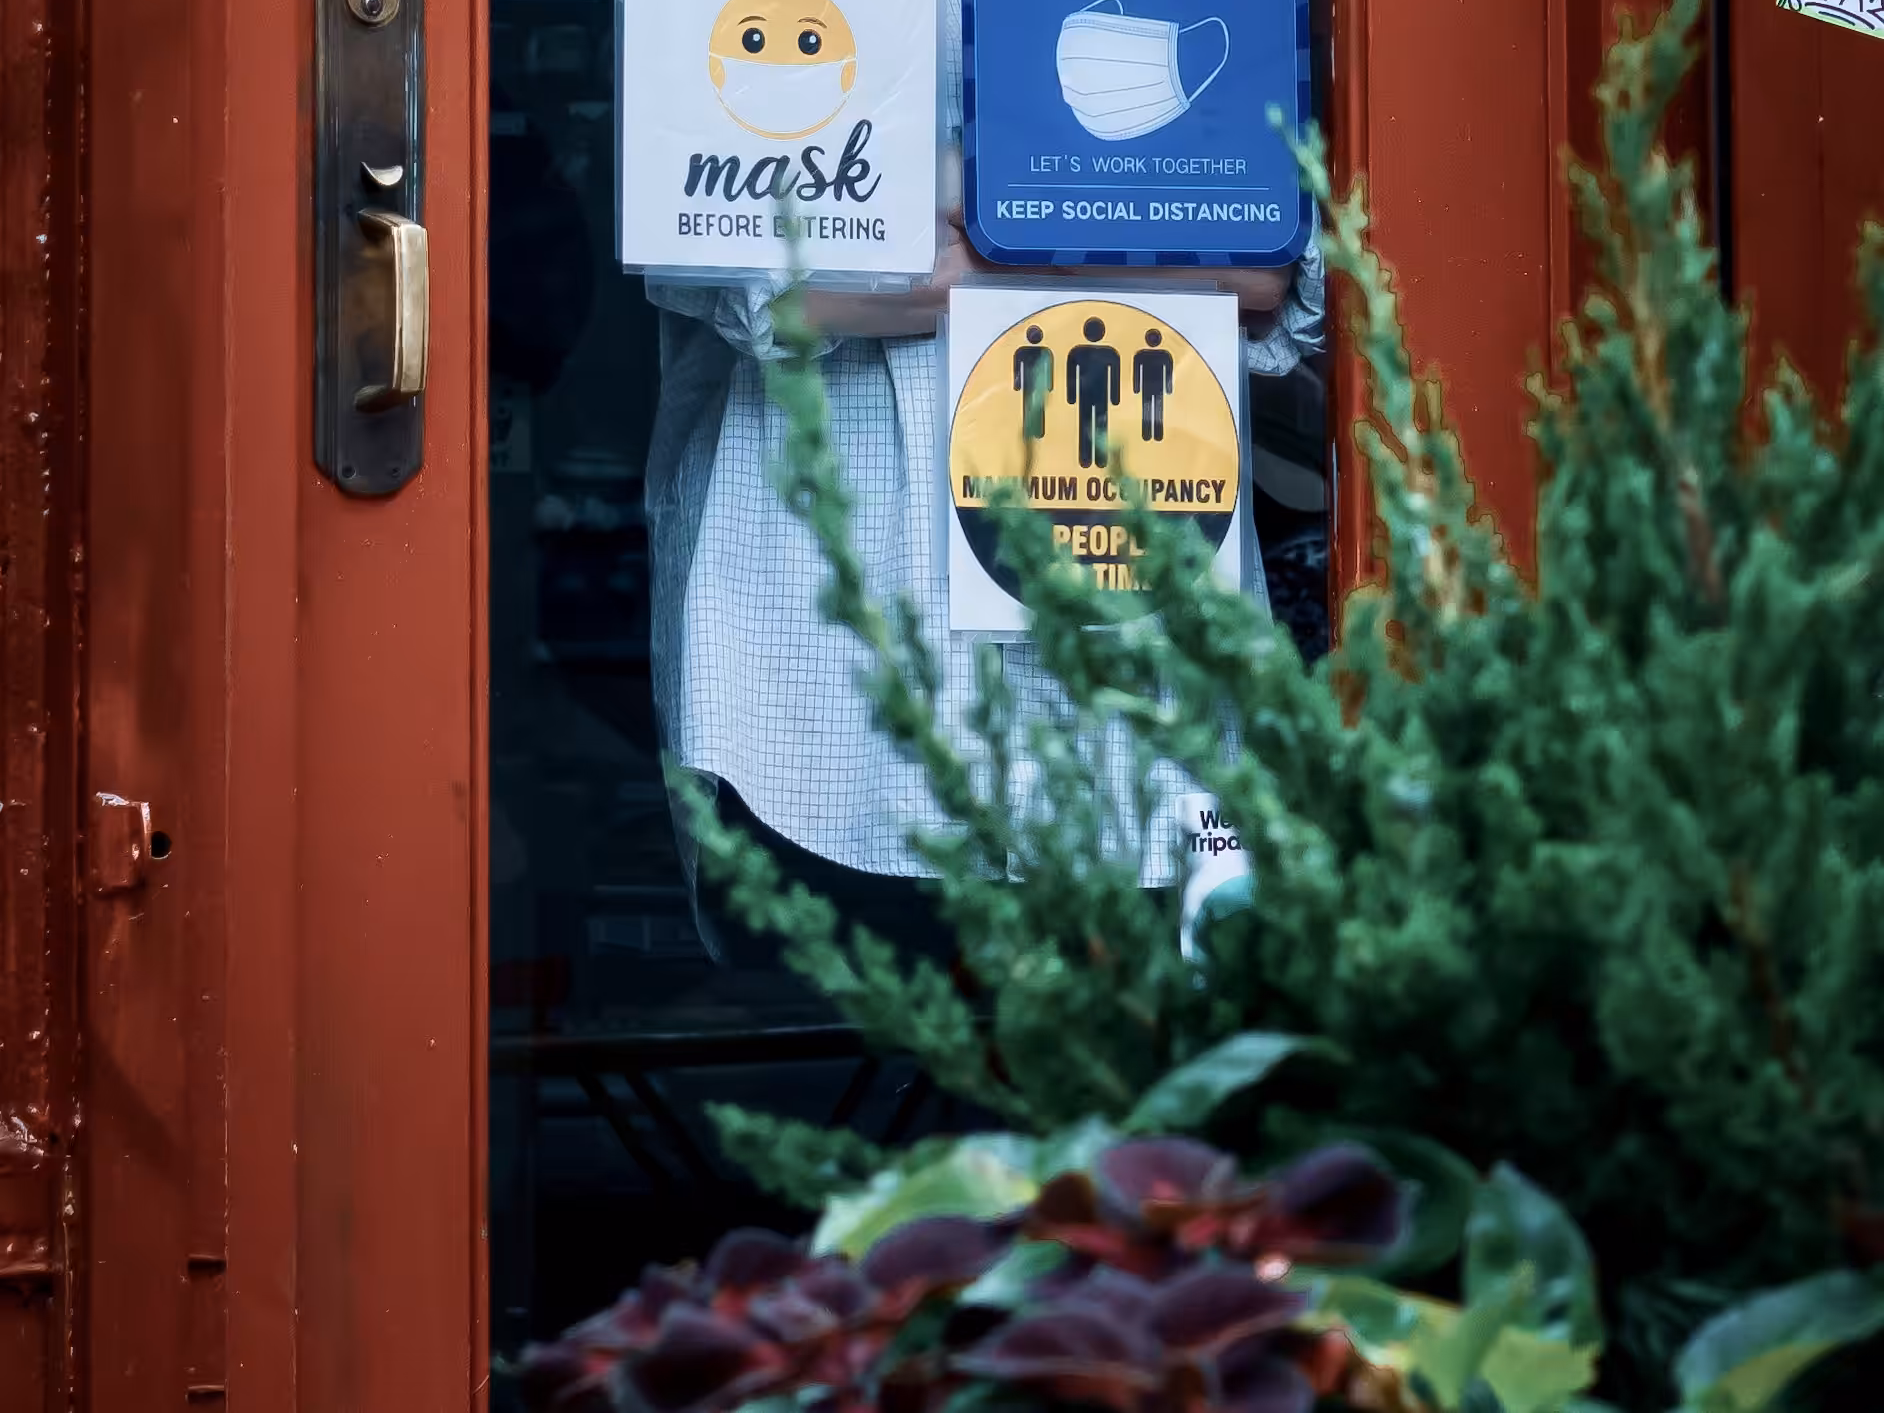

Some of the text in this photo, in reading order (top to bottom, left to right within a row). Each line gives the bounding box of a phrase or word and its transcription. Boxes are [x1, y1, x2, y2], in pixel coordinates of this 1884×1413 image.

[683, 119, 882, 203] mask
[1030, 155, 1248, 176] LET'S WORK TOGETHER
[997, 200, 1281, 222] KEEP SOCIAL DISTANCING
[678, 212, 886, 241] BEFORE ETERING
[962, 475, 1078, 501] MMUM
[1053, 524, 1147, 556] PEOPL
